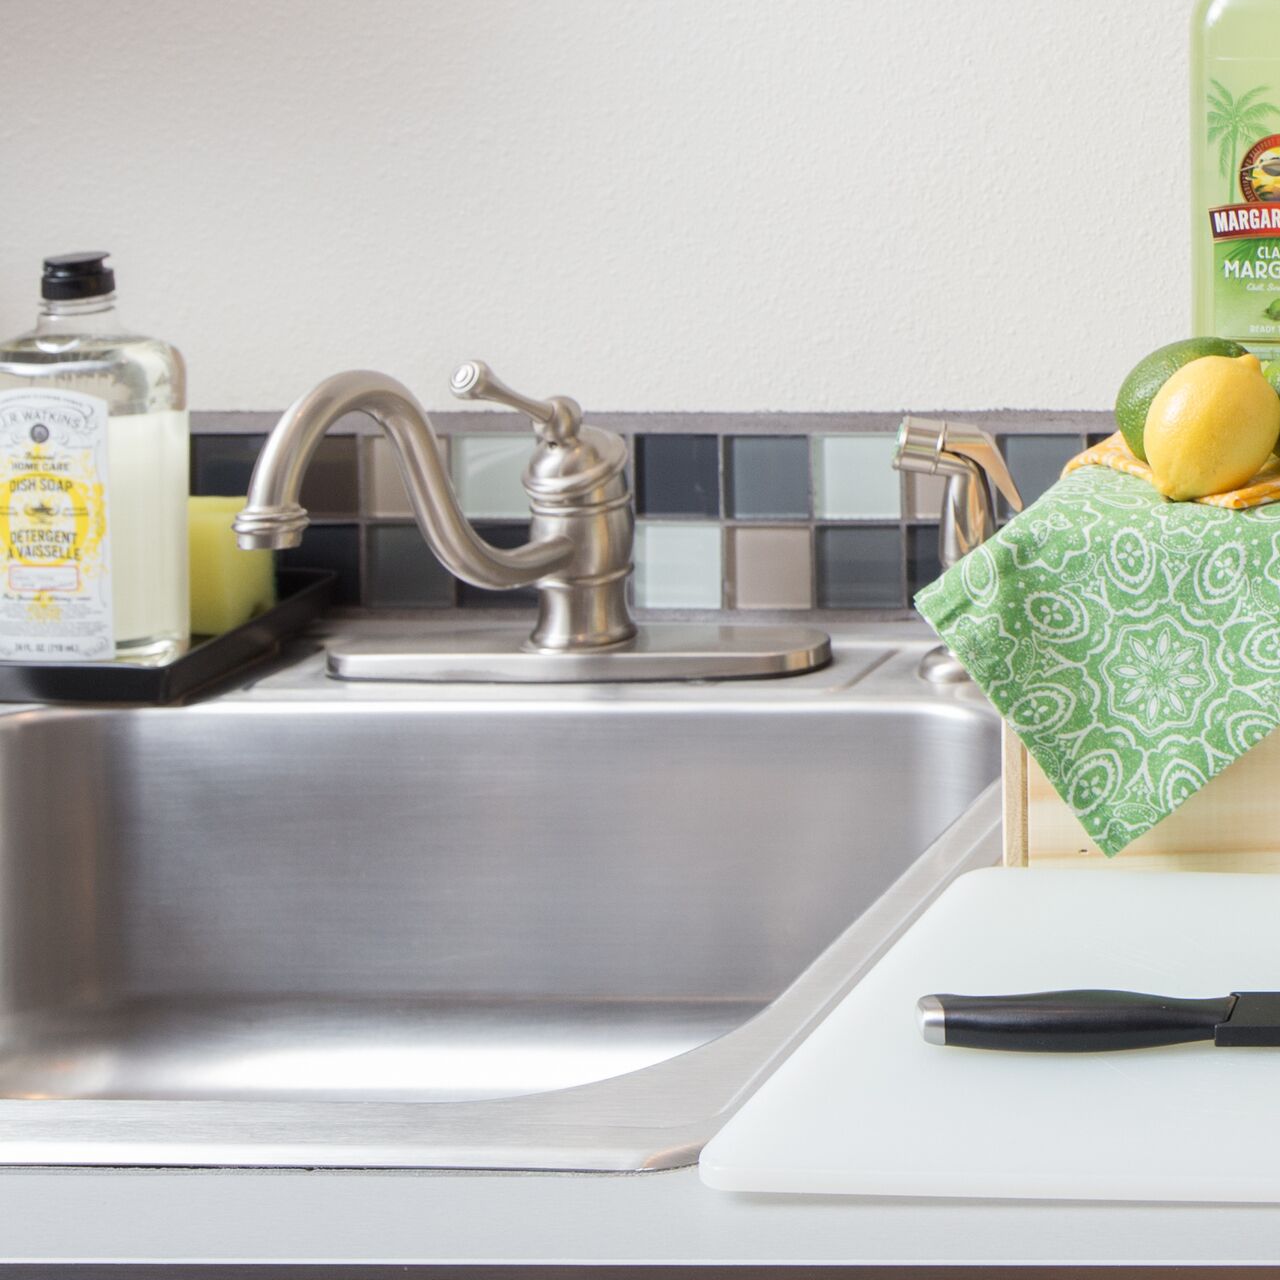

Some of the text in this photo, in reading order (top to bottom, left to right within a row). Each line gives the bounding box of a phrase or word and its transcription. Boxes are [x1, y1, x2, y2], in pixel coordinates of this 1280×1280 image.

[1249, 325, 1275, 333] READY
[12, 462, 70, 471] HOME CARE
[9, 478, 74, 493] DISH SOAP
[10, 529, 77, 545] DETERGENT
[16, 545, 82, 562] VAISSELLE
